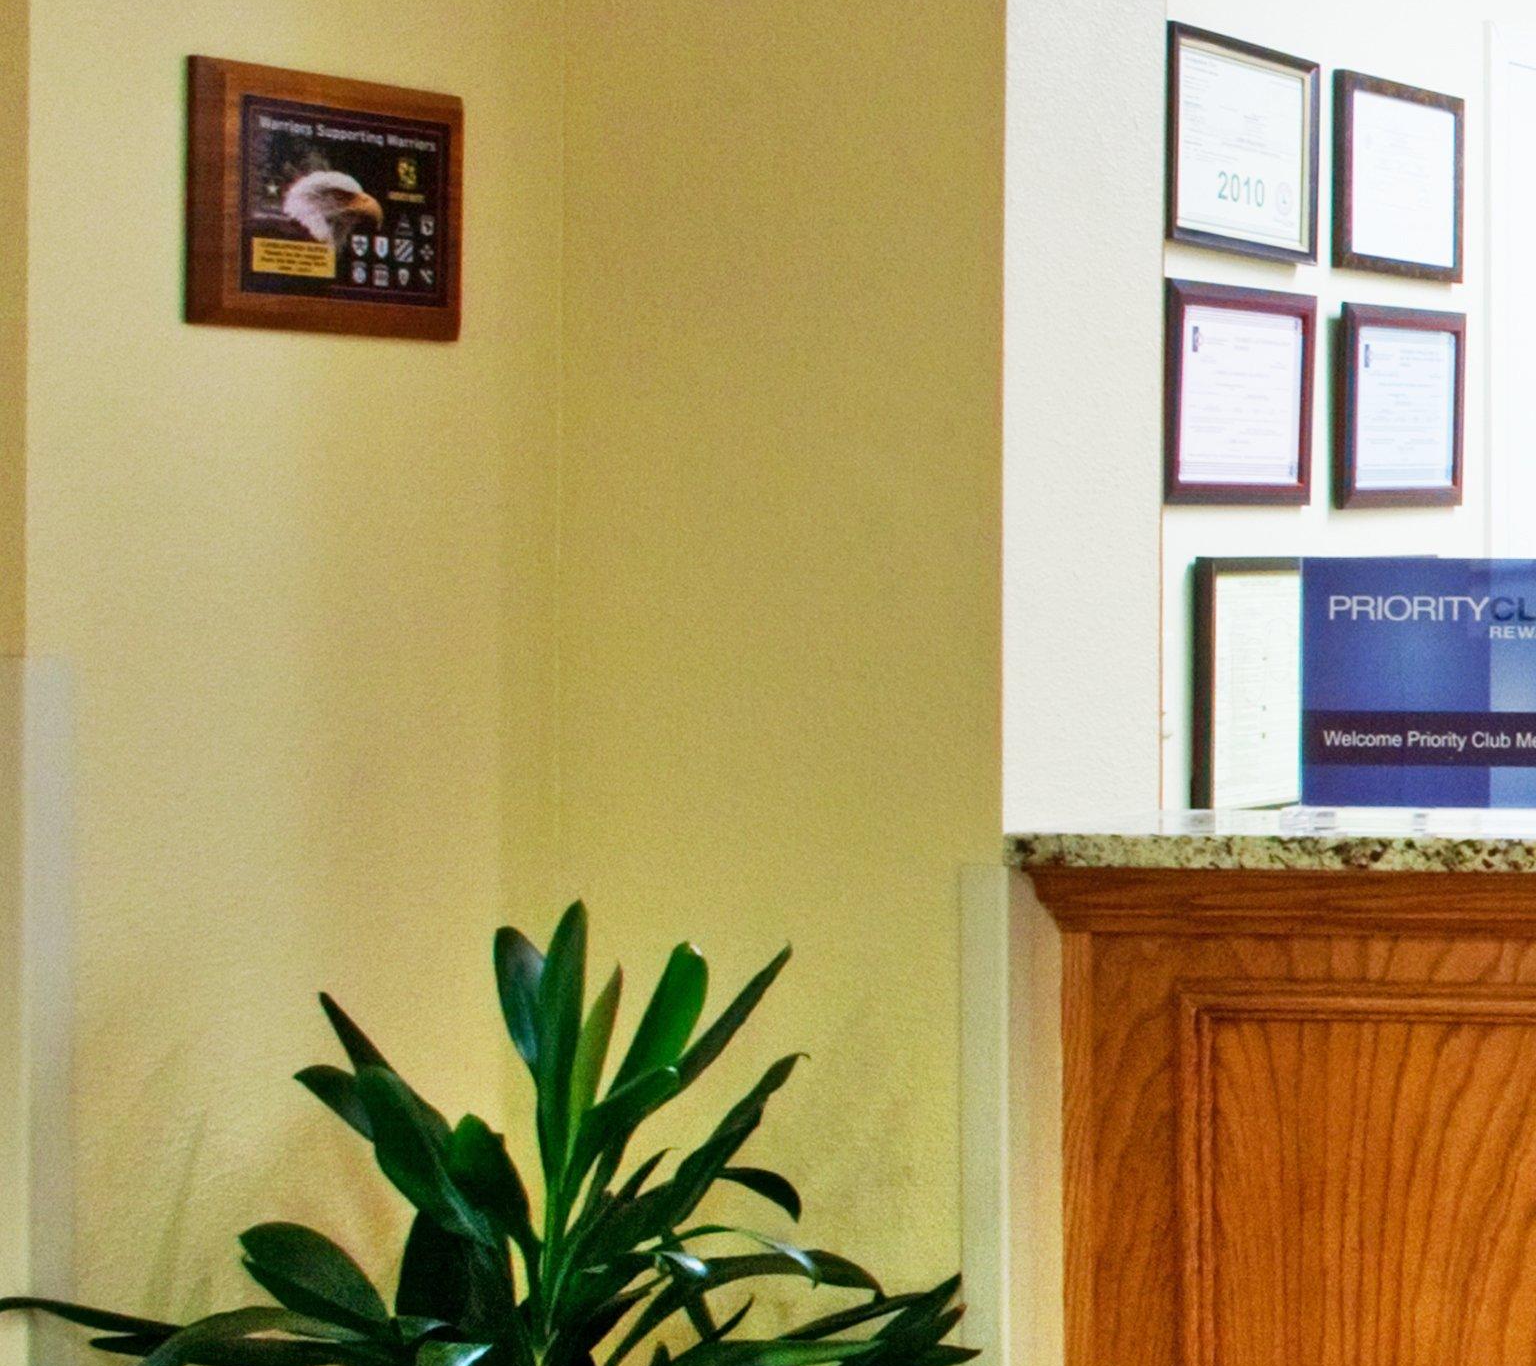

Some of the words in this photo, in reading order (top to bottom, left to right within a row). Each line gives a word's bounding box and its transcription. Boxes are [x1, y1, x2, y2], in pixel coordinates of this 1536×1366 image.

[316, 123, 385, 147] Supporting
[386, 134, 437, 153] Warriors
[1217, 170, 1265, 208] 2010
[1323, 730, 1402, 748] Welcome
[1407, 730, 1467, 752] Priority
[1472, 730, 1511, 749] Club
